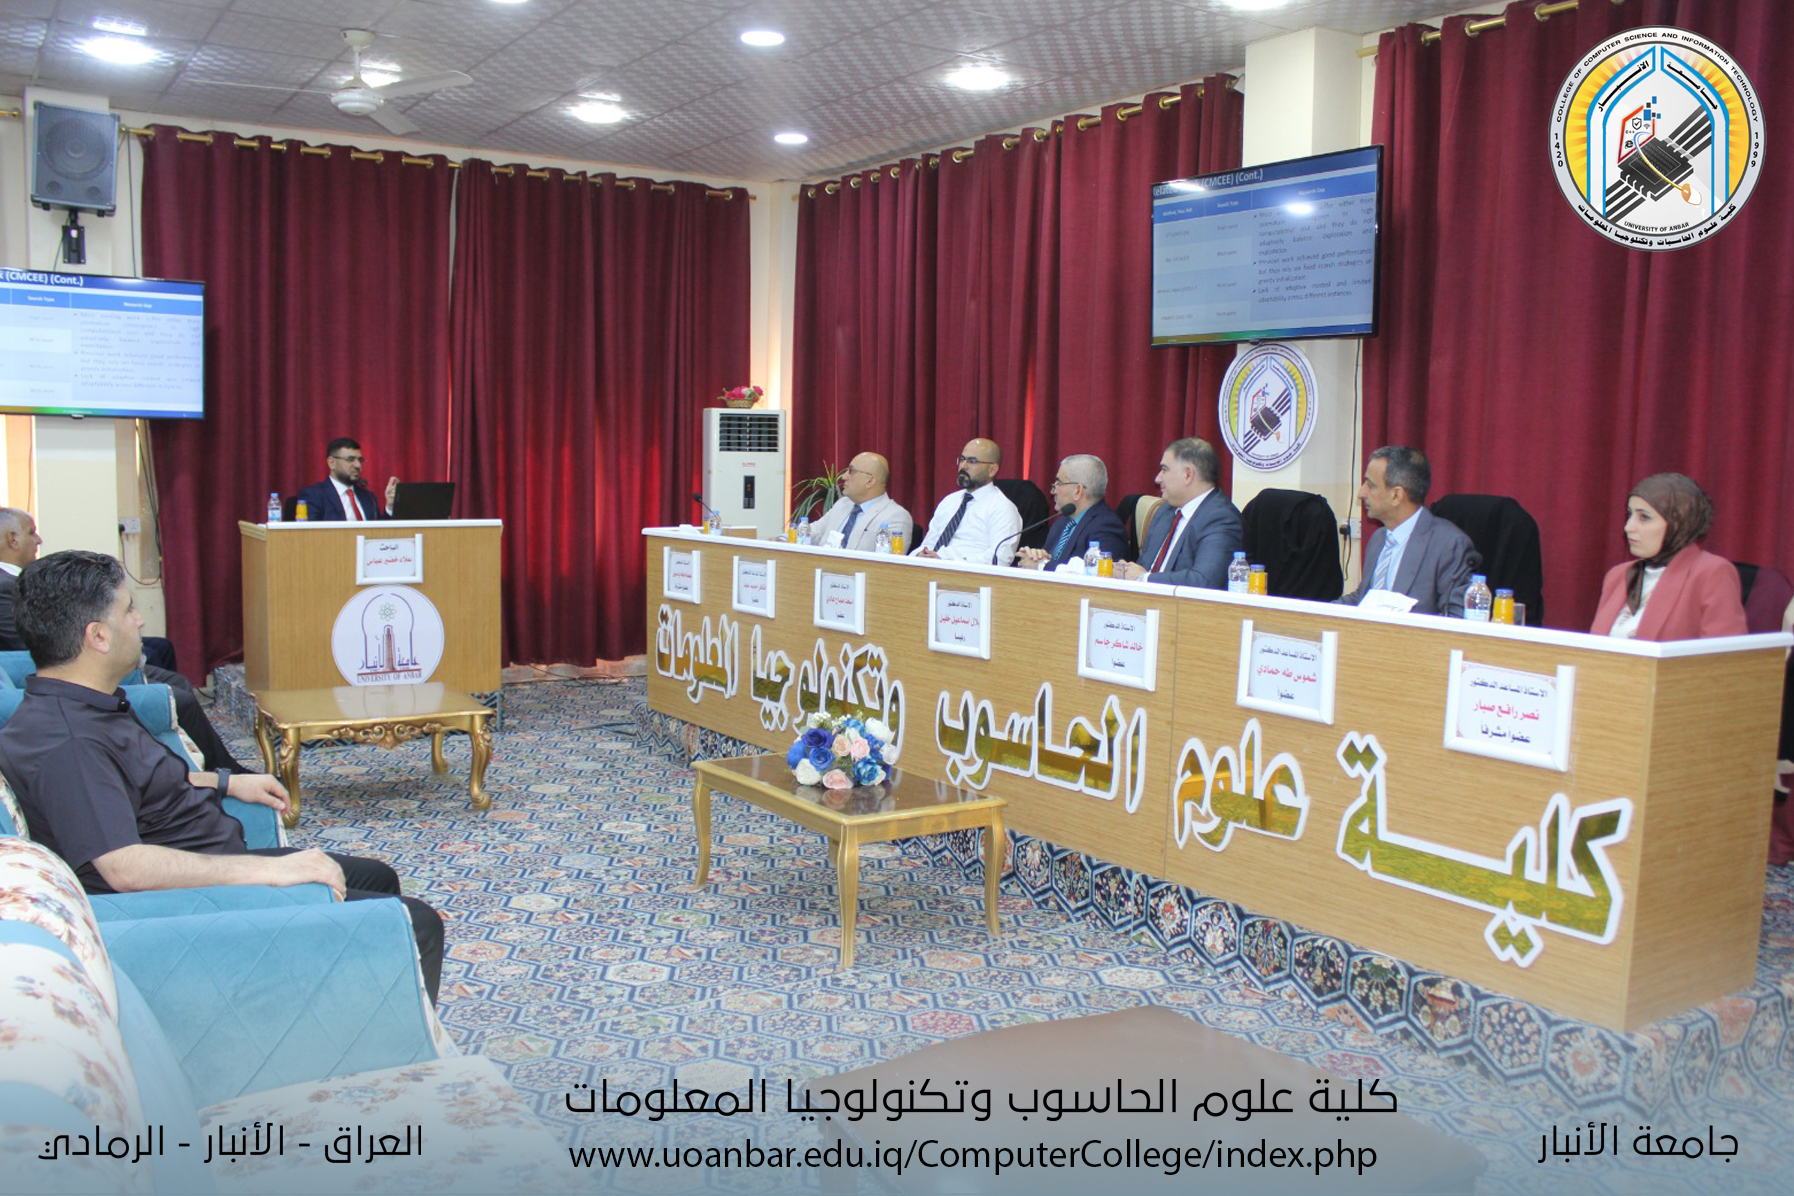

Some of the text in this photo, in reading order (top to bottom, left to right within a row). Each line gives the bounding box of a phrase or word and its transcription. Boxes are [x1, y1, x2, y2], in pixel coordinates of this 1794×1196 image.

[1201, 175, 1234, 190] (CMCEE)
[1235, 168, 1264, 184] (Cont.)
[6, 271, 84, 287] (CMCEE) (Cont.)
[656, 603, 739, 704] المعلومات
[1111, 638, 1129, 649] شاكر
[1130, 641, 1143, 651] خالد
[357, 670, 422, 683] UNIVERSITY OF ANBAR
[1281, 667, 1293, 678] طه
[1293, 672, 1317, 683] شموس
[1473, 699, 1540, 720] نصر رافع صبار
[1481, 723, 1531, 743] عضوا مشرفا
[936, 682, 1147, 814] الحاسوب
[1173, 717, 1311, 852] علوم
[1336, 731, 1633, 967] كلية
